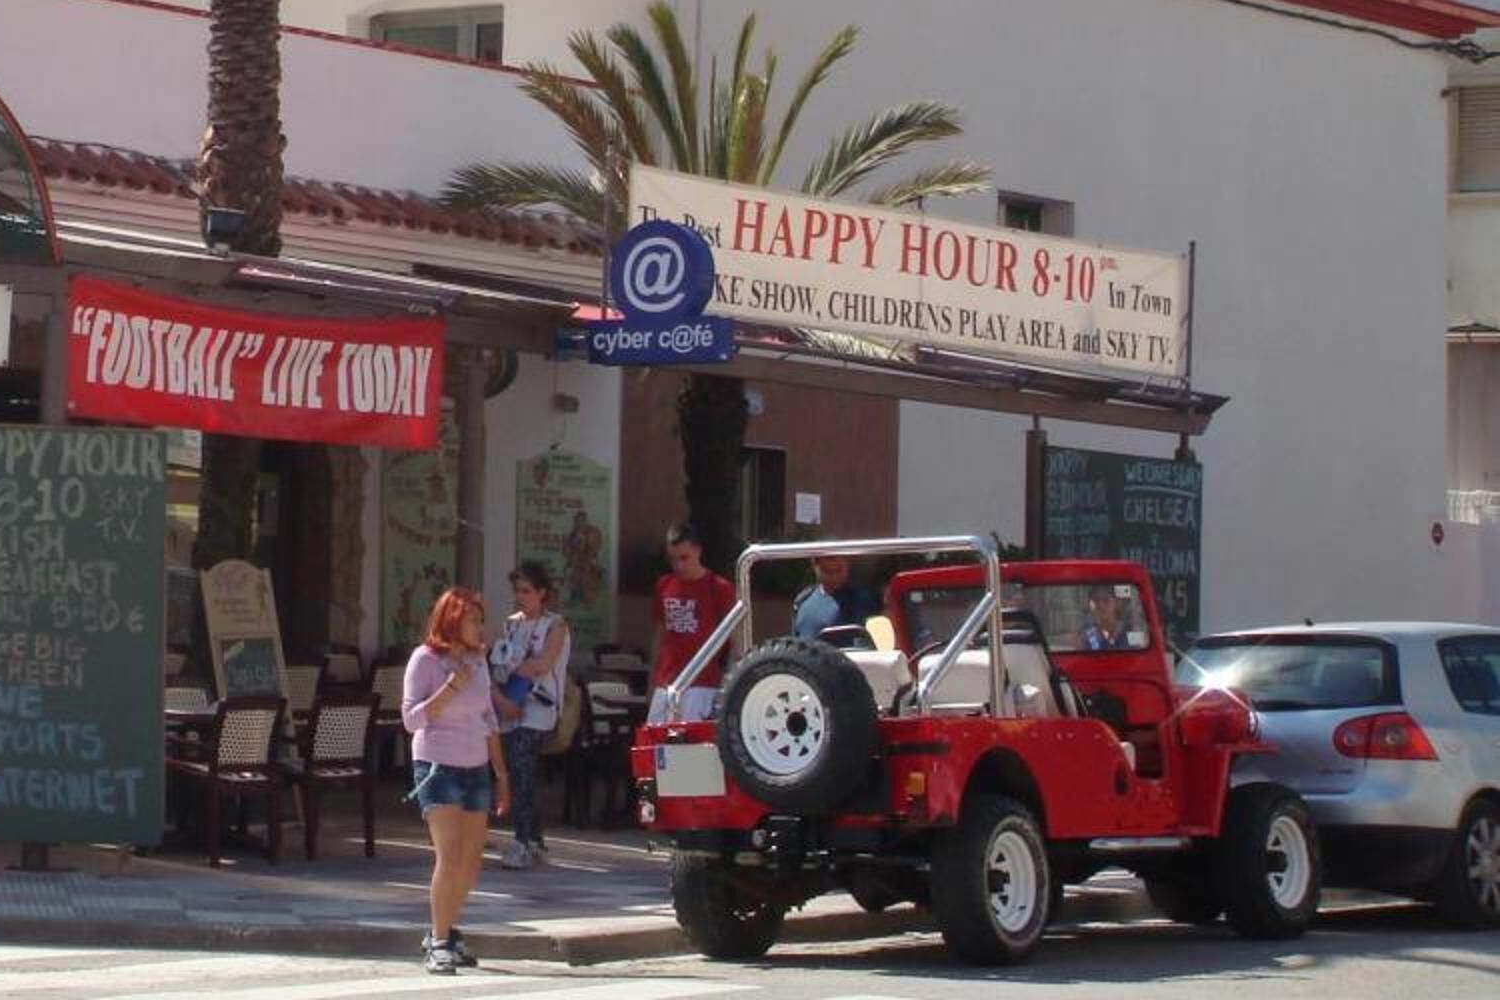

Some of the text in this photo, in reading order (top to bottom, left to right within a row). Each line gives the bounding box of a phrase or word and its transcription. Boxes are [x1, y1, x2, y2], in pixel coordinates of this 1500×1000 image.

[732, 199, 884, 268] HAPPY
[900, 223, 1018, 293] HOUR
[1032, 248, 1095, 303] 8-10
[1109, 282, 1124, 308] In
[1130, 285, 1171, 316] Town
[594, 323, 713, 355] cyber c@fé
[749, 279, 822, 320] SHOW,
[829, 290, 952, 334] CHILDRENS
[959, 309, 1010, 343] PLAY
[1016, 318, 1067, 351] AREA
[1073, 329, 1100, 355] and
[1106, 330, 1141, 360] SKY
[260, 336, 334, 410] LIVE
[336, 343, 433, 417] TODAY
[59, 434, 165, 482] HOUR
[1124, 497, 1196, 528] CHELSEA
[35, 634, 88, 661] BIG
